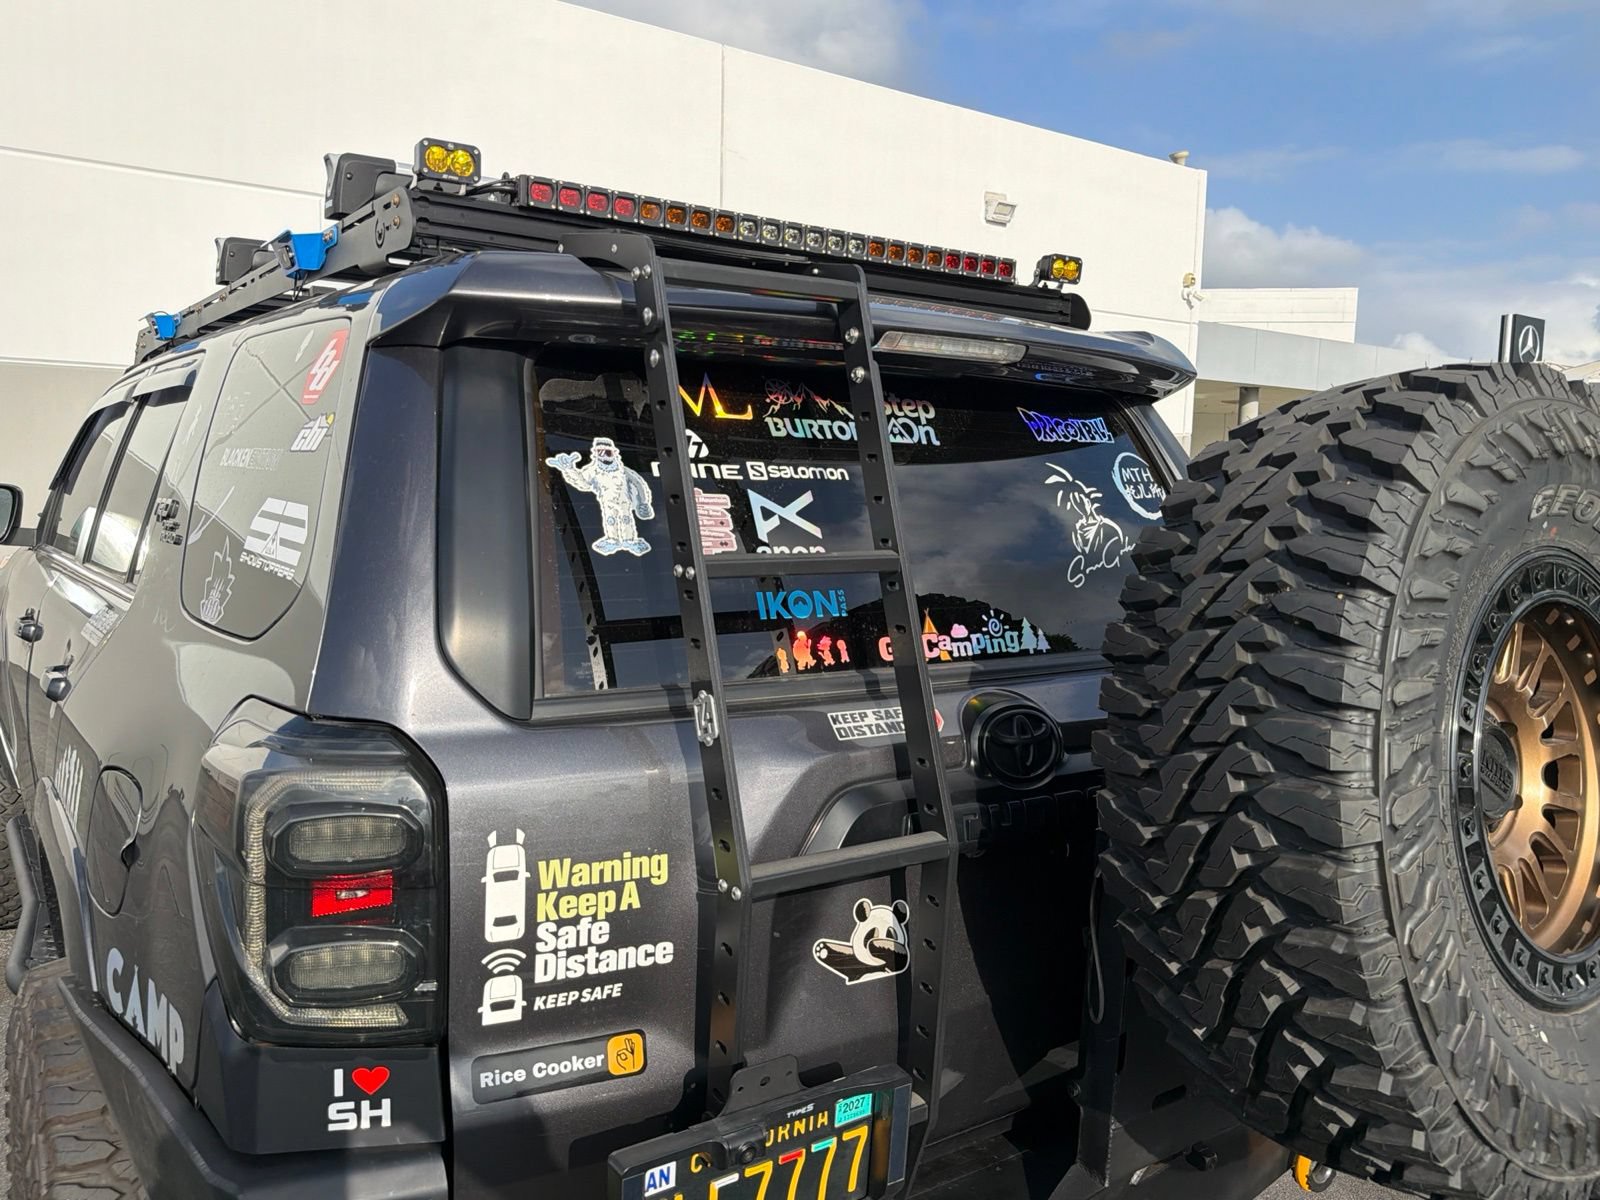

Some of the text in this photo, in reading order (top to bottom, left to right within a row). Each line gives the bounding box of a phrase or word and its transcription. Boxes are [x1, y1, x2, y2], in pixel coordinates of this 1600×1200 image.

[1121, 467, 1154, 482] MTH
[1528, 484, 1600, 534] GEO
[755, 590, 840, 620] IKON
[829, 708, 904, 726] KEEP SAF
[835, 721, 905, 739] DISTAN
[537, 851, 669, 890] Warning
[536, 881, 641, 922] Keep A
[535, 917, 610, 953] Safe
[533, 941, 674, 984] Distance
[106, 947, 185, 1075] CAMP
[533, 983, 623, 1011] KEEP SAFE
[479, 1053, 605, 1089] Rice Cooker
[327, 1098, 392, 1132] SH
[842, 1096, 866, 1114] 2027
[645, 1165, 672, 1193] AN
